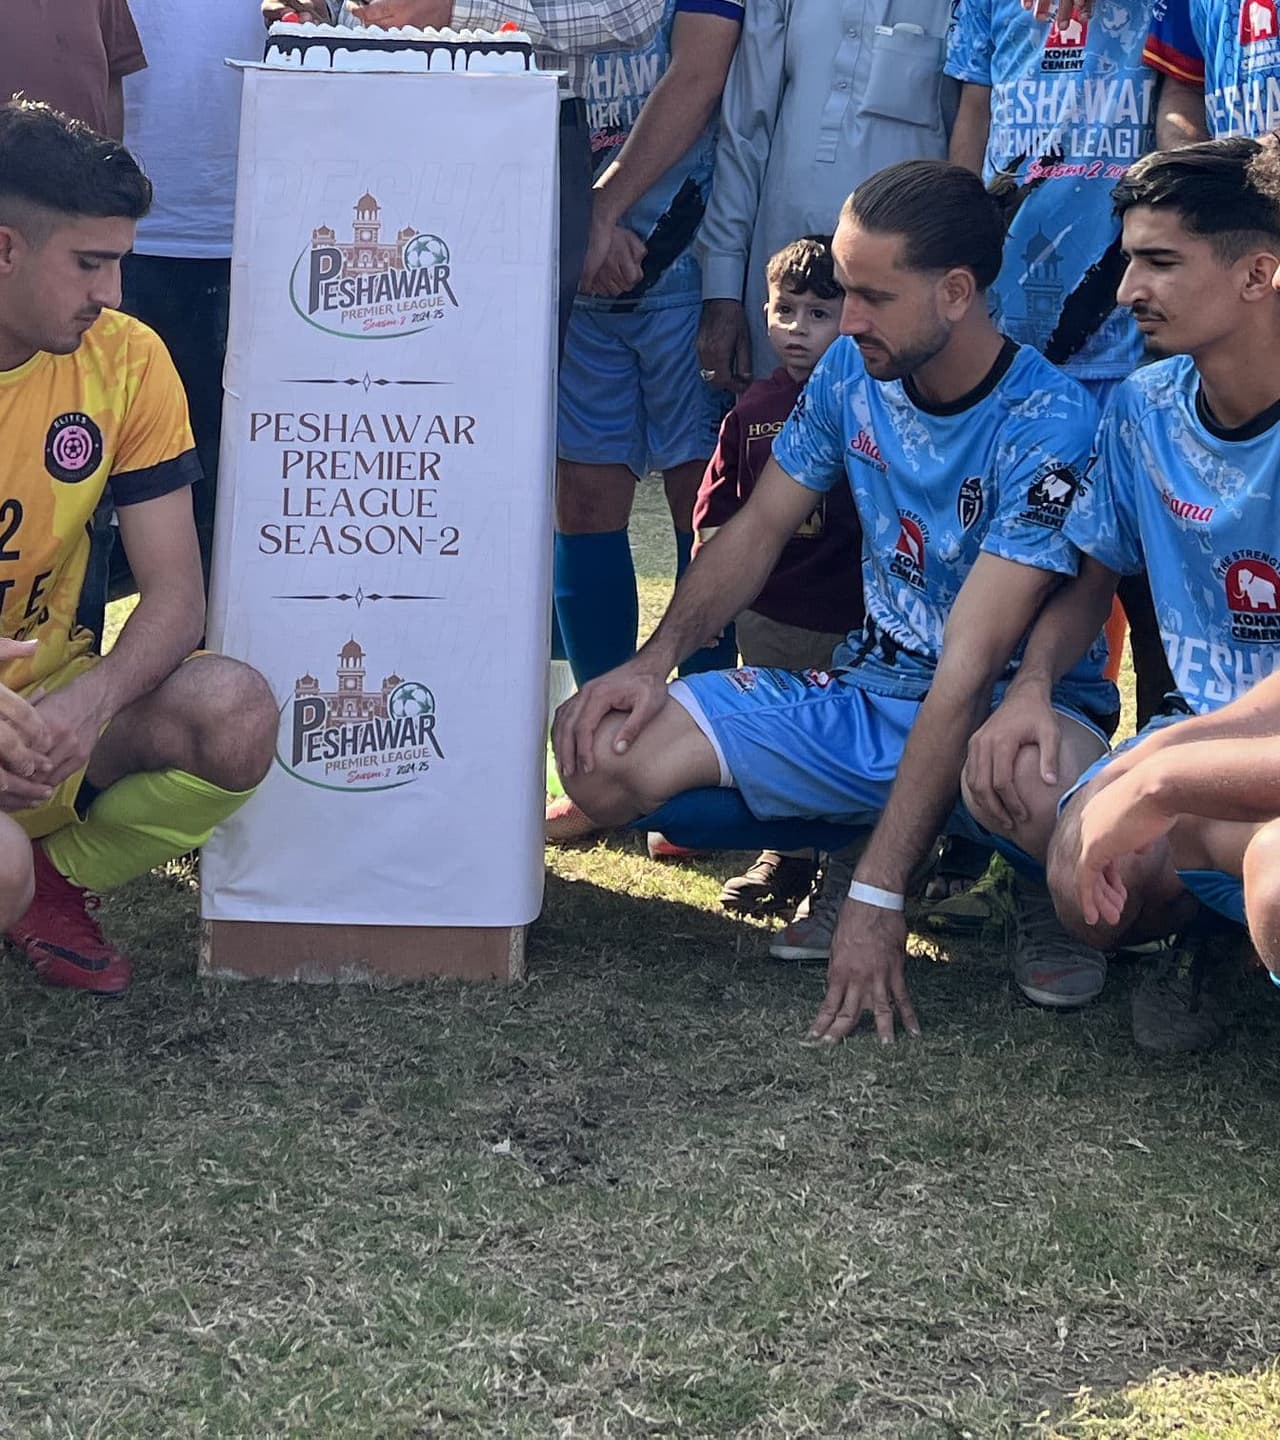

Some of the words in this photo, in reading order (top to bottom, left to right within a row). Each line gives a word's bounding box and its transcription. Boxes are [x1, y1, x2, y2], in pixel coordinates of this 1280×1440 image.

[1040, 59, 1085, 70] CEMENT
[1044, 48, 1084, 59] KOHAT
[308, 246, 459, 315] PESHAWAR
[341, 304, 394, 324] PREMIER
[397, 296, 446, 312] LEAGUE
[249, 413, 476, 445] PESHAWAR
[281, 450, 441, 481] PREMIER
[282, 487, 438, 519] LEAGUE
[258, 524, 460, 556] SEASON-2
[1218, 555, 1232, 576] THE
[292, 696, 445, 768] PESHAWAR
[325, 755, 378, 776] PREMIER
[381, 747, 431, 764] LEAGUE
